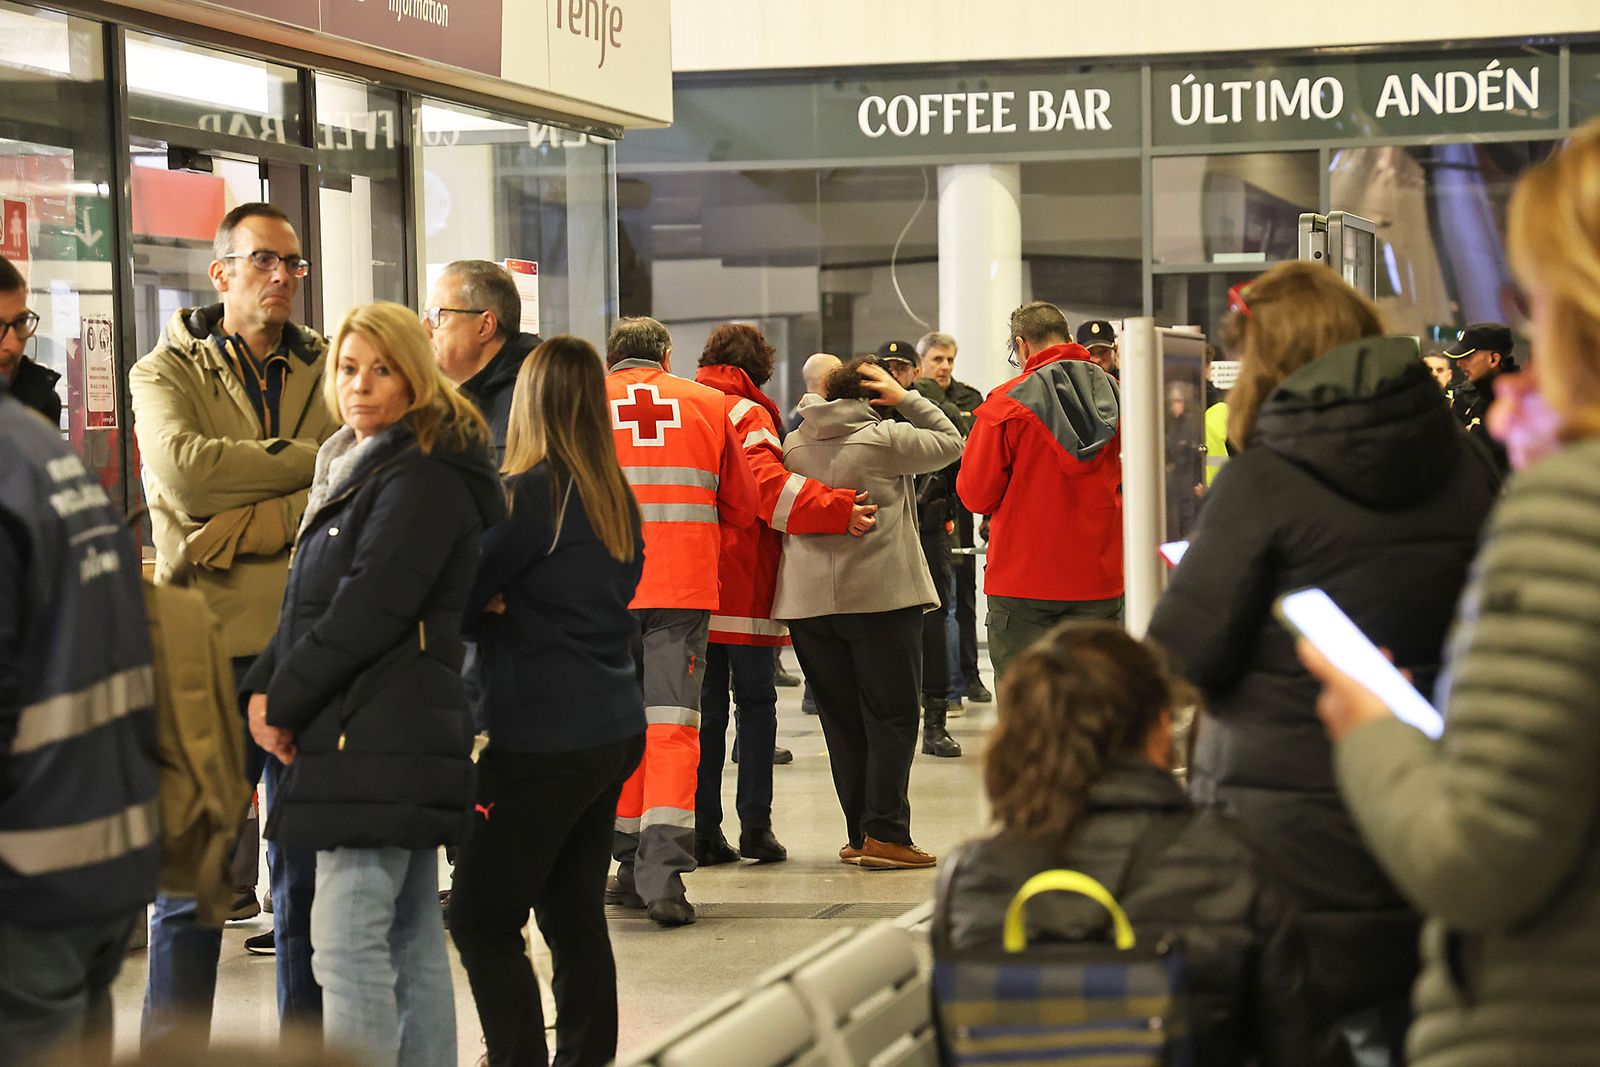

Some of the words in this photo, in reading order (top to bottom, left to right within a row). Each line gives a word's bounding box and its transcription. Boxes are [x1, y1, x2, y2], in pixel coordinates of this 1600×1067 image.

[556, 0, 623, 69] renfe
[857, 91, 1017, 138] COFFEE
[1028, 88, 1113, 132] BAR
[1170, 73, 1345, 126] ÚLTIMO
[1375, 58, 1541, 119] ANDÉN
